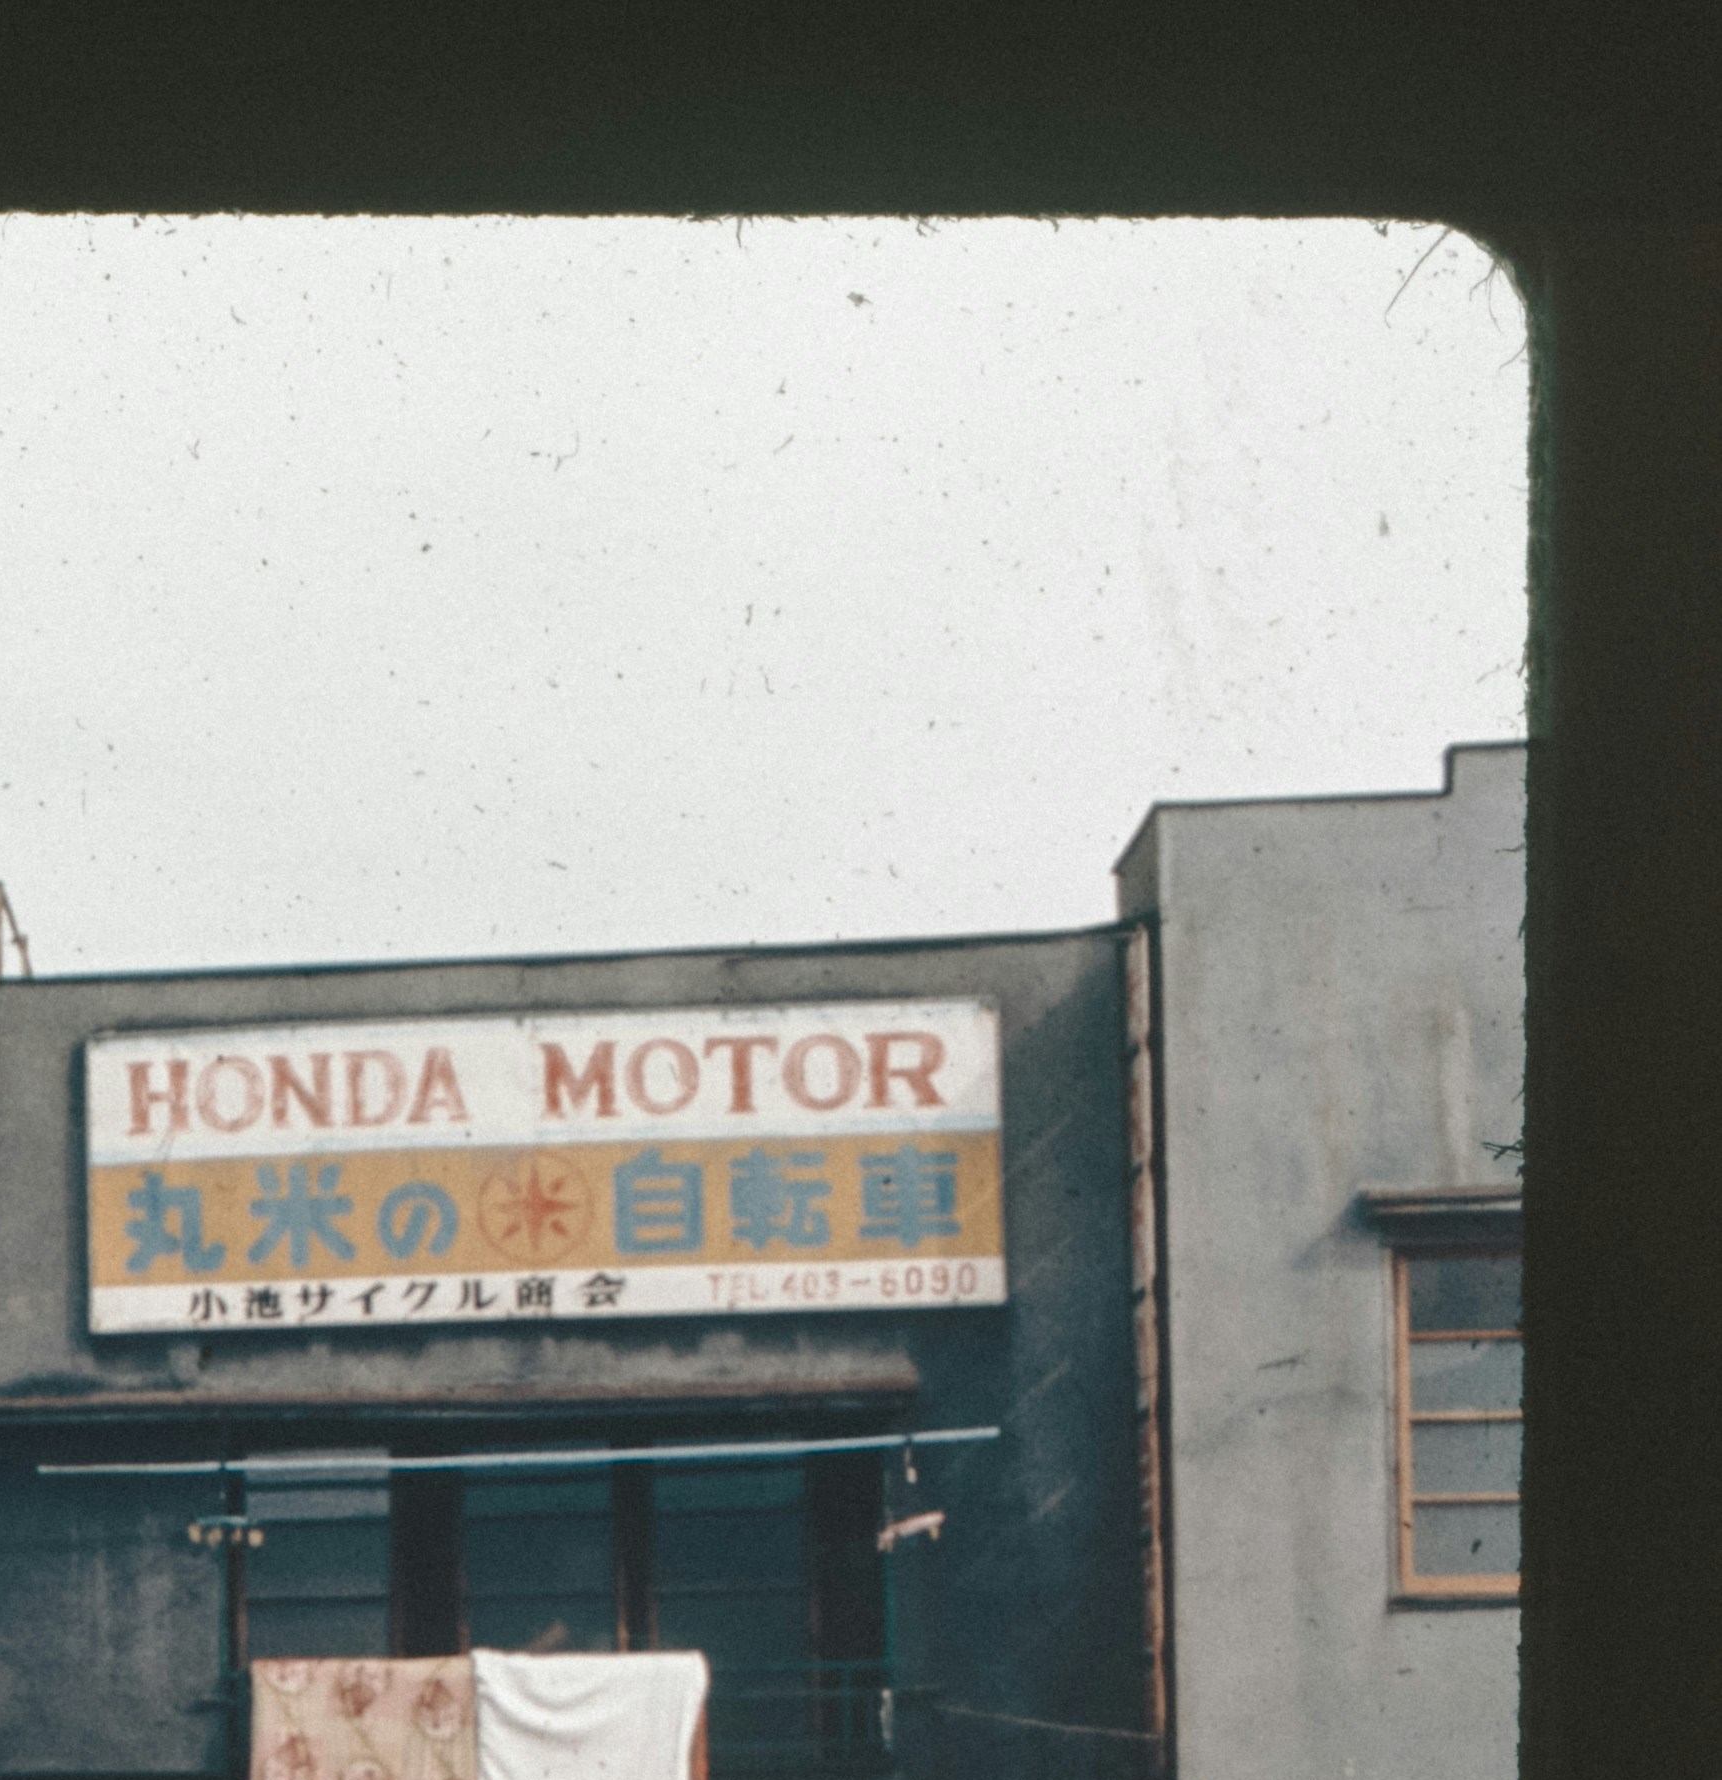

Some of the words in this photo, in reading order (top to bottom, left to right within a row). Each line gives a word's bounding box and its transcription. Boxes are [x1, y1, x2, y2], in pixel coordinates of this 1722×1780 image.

[124, 1044, 471, 1136] HONDA
[537, 1029, 950, 1119] MOTOR
[123, 1162, 460, 1274] 丸米の
[611, 1144, 963, 1256] 自転車
[187, 1271, 627, 1323] 小池サイクル商会
